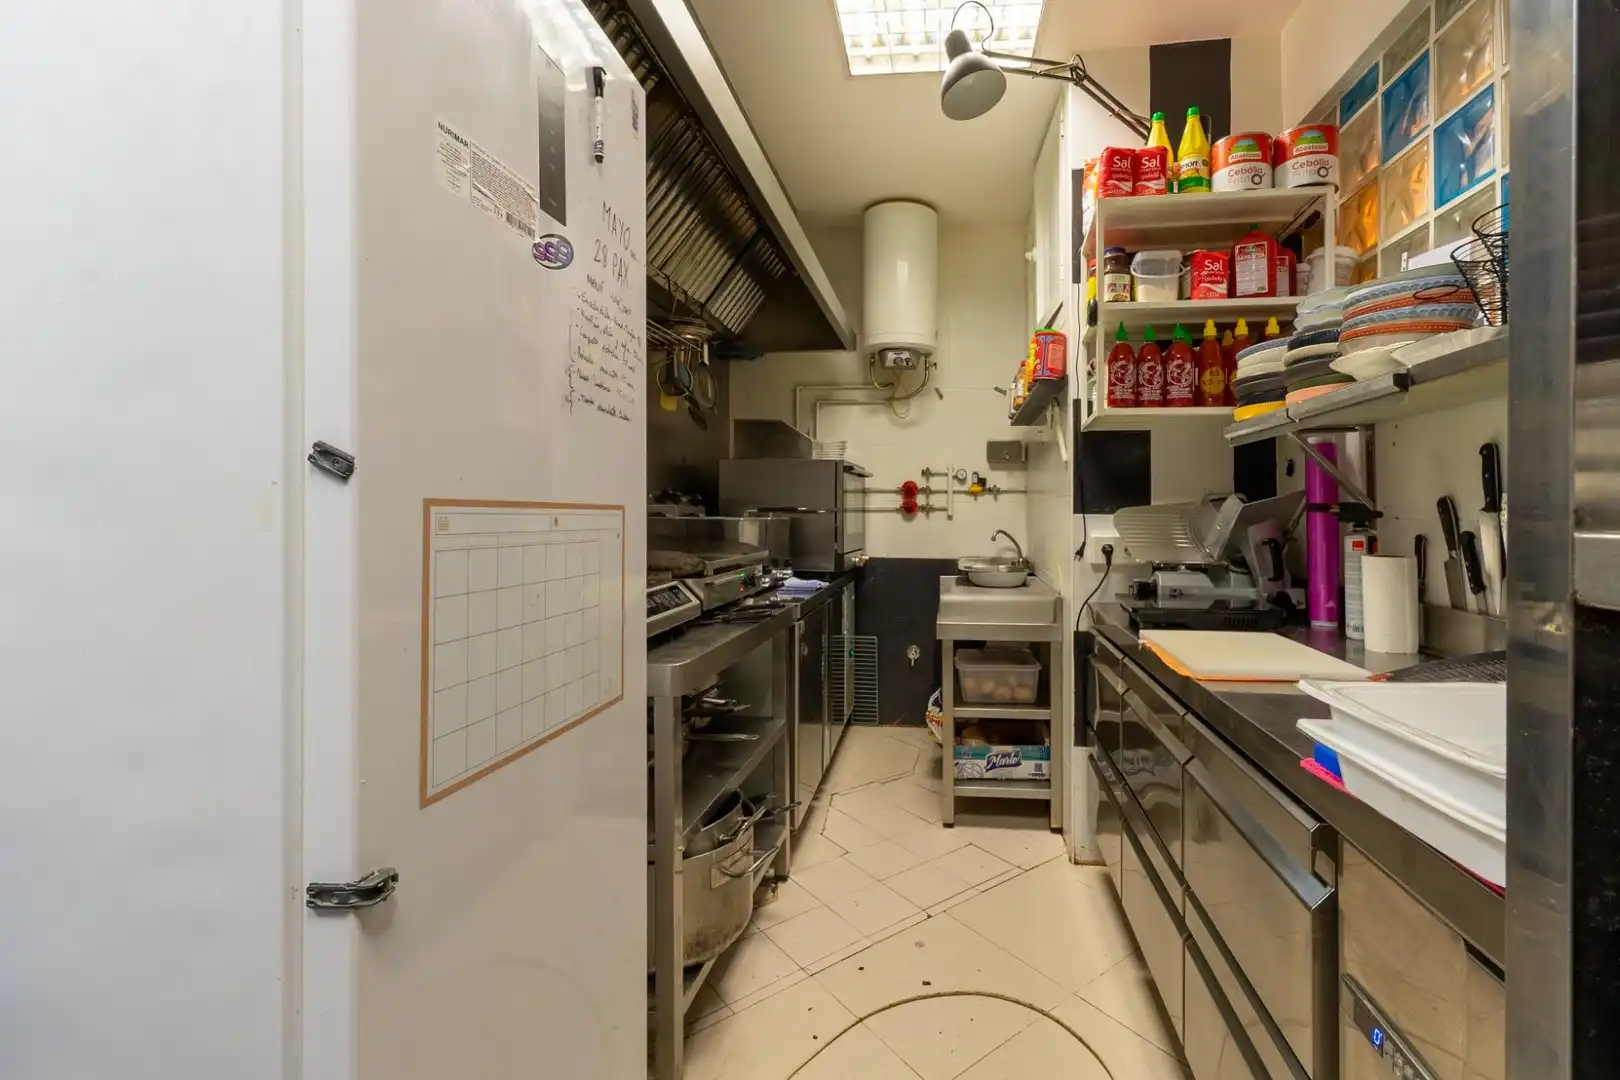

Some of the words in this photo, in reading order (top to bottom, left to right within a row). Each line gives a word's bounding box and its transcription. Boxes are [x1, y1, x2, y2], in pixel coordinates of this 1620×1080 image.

[1112, 155, 1131, 169] Sal
[1141, 154, 1160, 169] Sal
[602, 200, 631, 251] MAYO
[593, 238, 607, 268] 28
[612, 252, 628, 288] PAX
[1204, 259, 1224, 272] Sal
